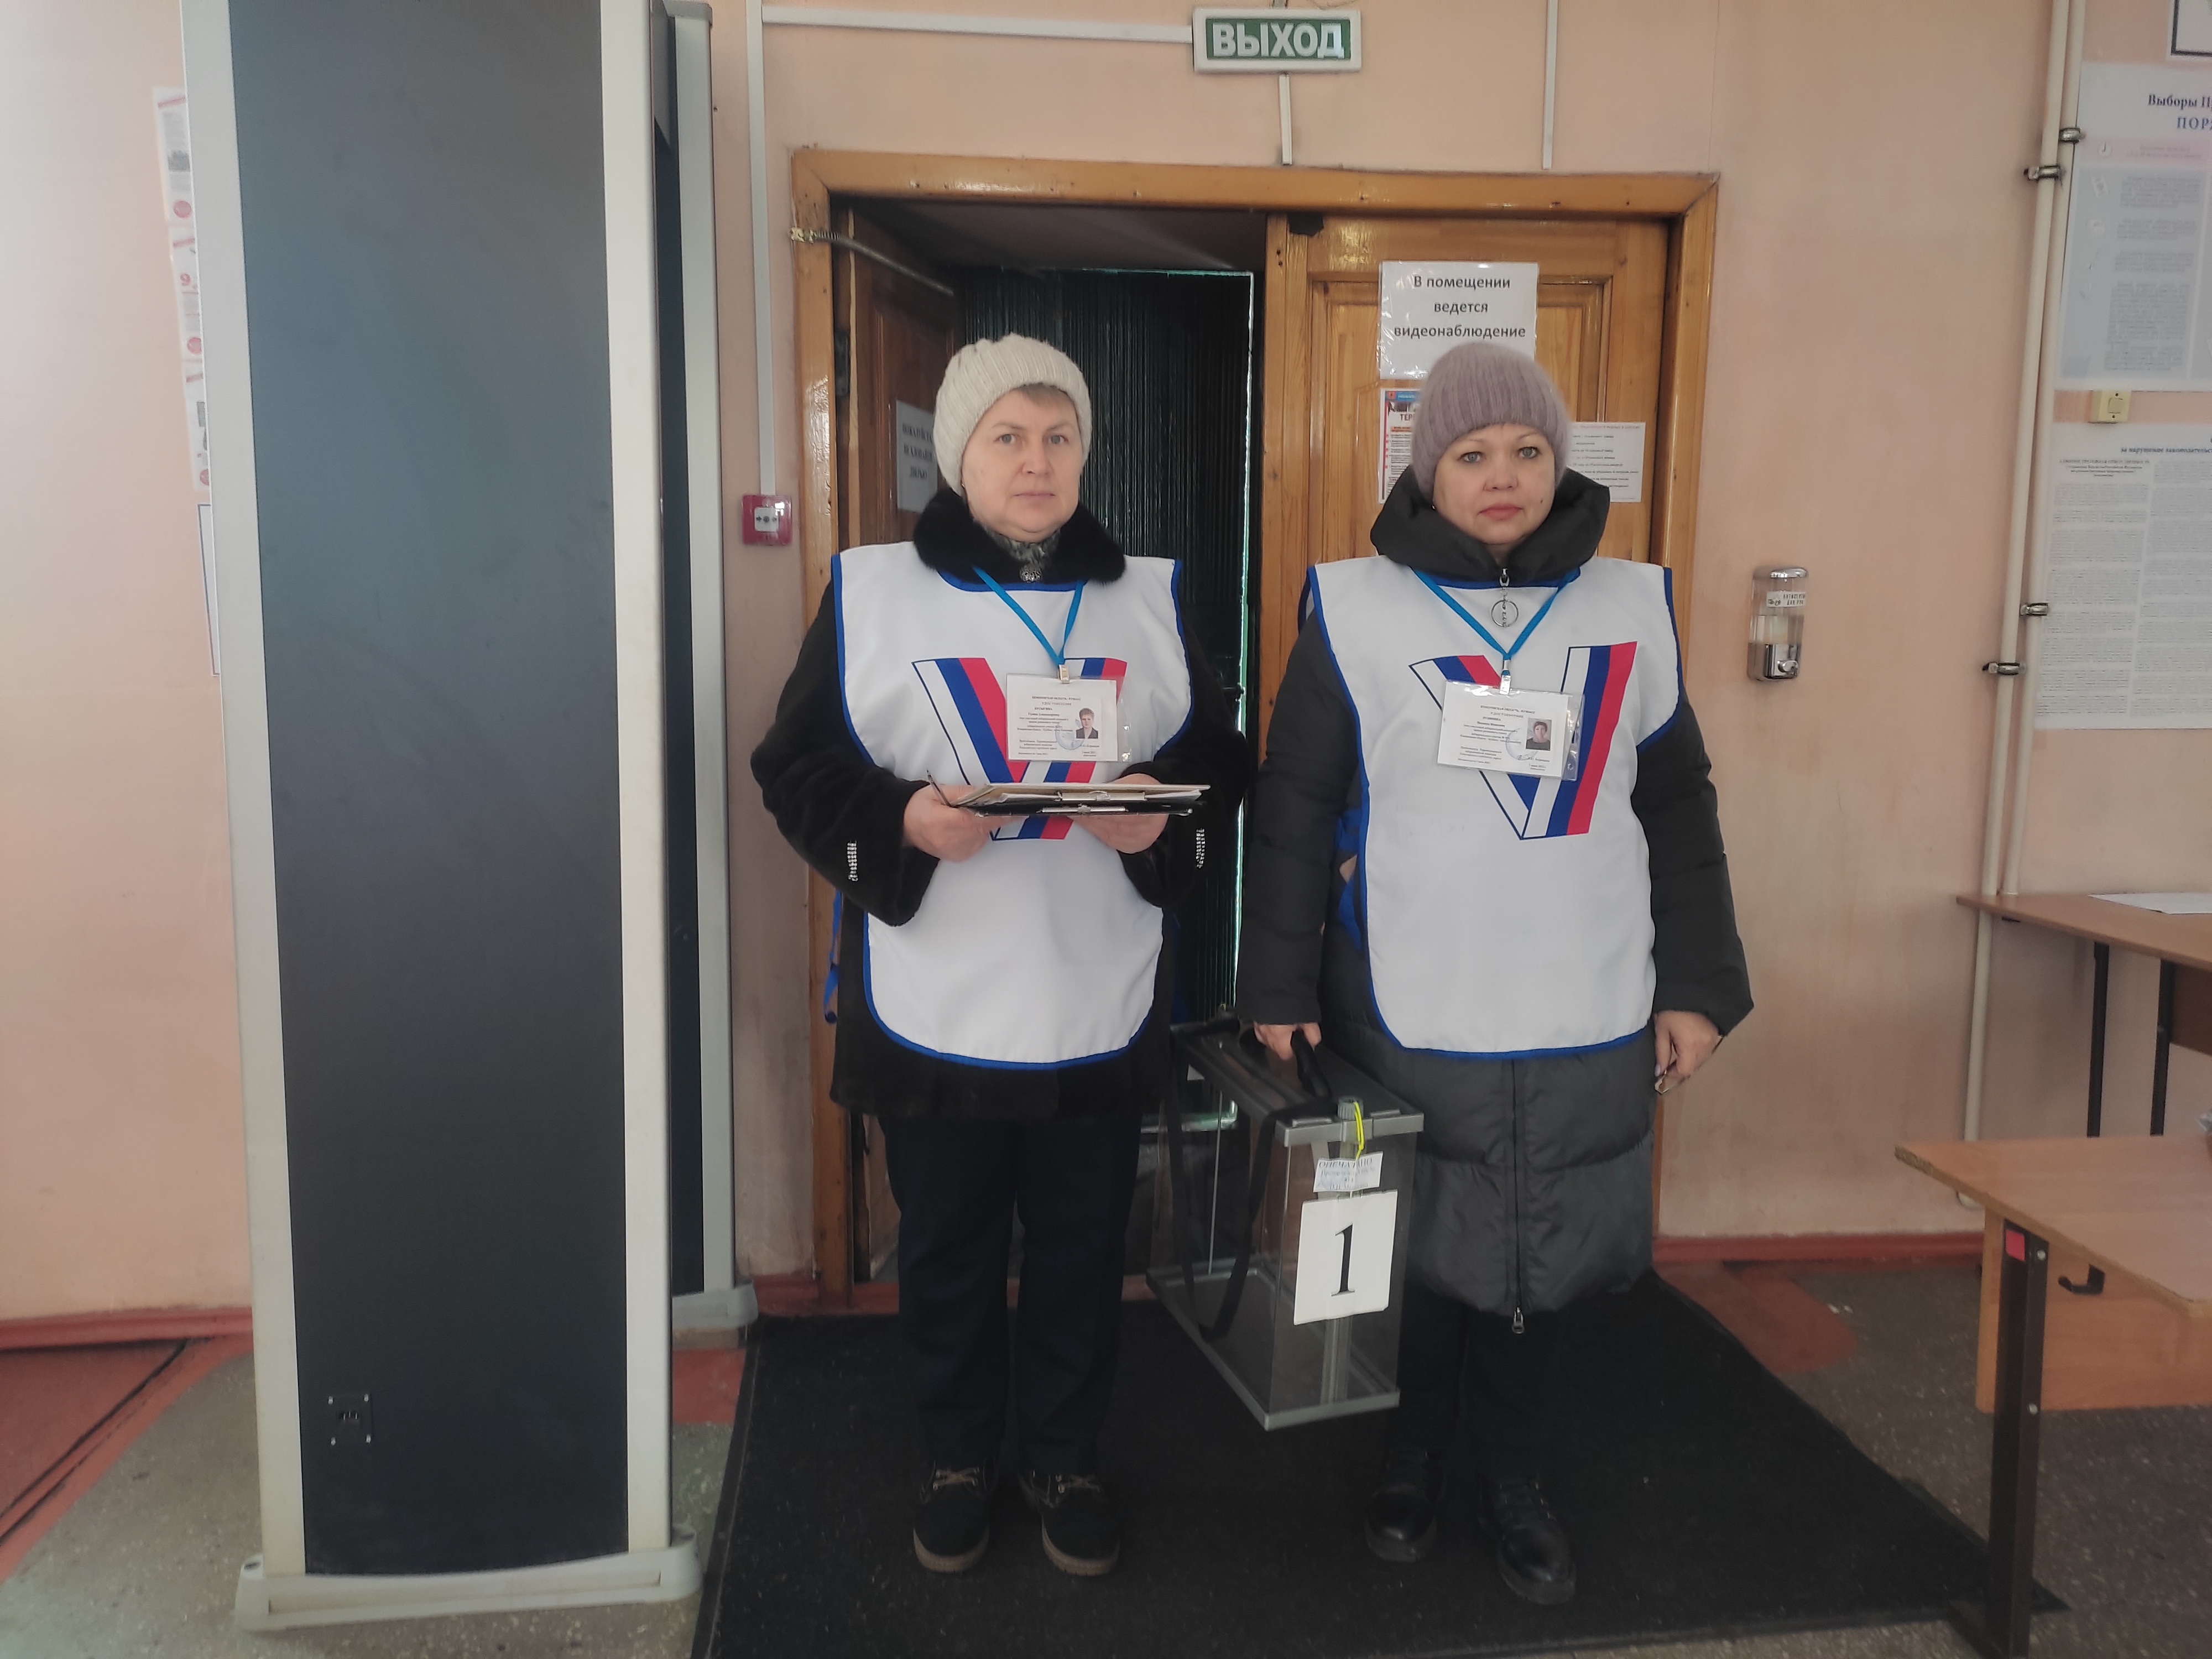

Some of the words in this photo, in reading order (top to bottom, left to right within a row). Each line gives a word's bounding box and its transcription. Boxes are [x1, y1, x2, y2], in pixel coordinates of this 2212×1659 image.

[1213, 22, 1344, 59] ВЫХОД
[2148, 94, 2197, 110] Выборы
[1414, 275, 1422, 288] В
[1427, 278, 1510, 291] помещении
[1434, 302, 1488, 315] ведется
[1394, 325, 1526, 339] видеонаблюдение
[1331, 1223, 1355, 1297] 1
